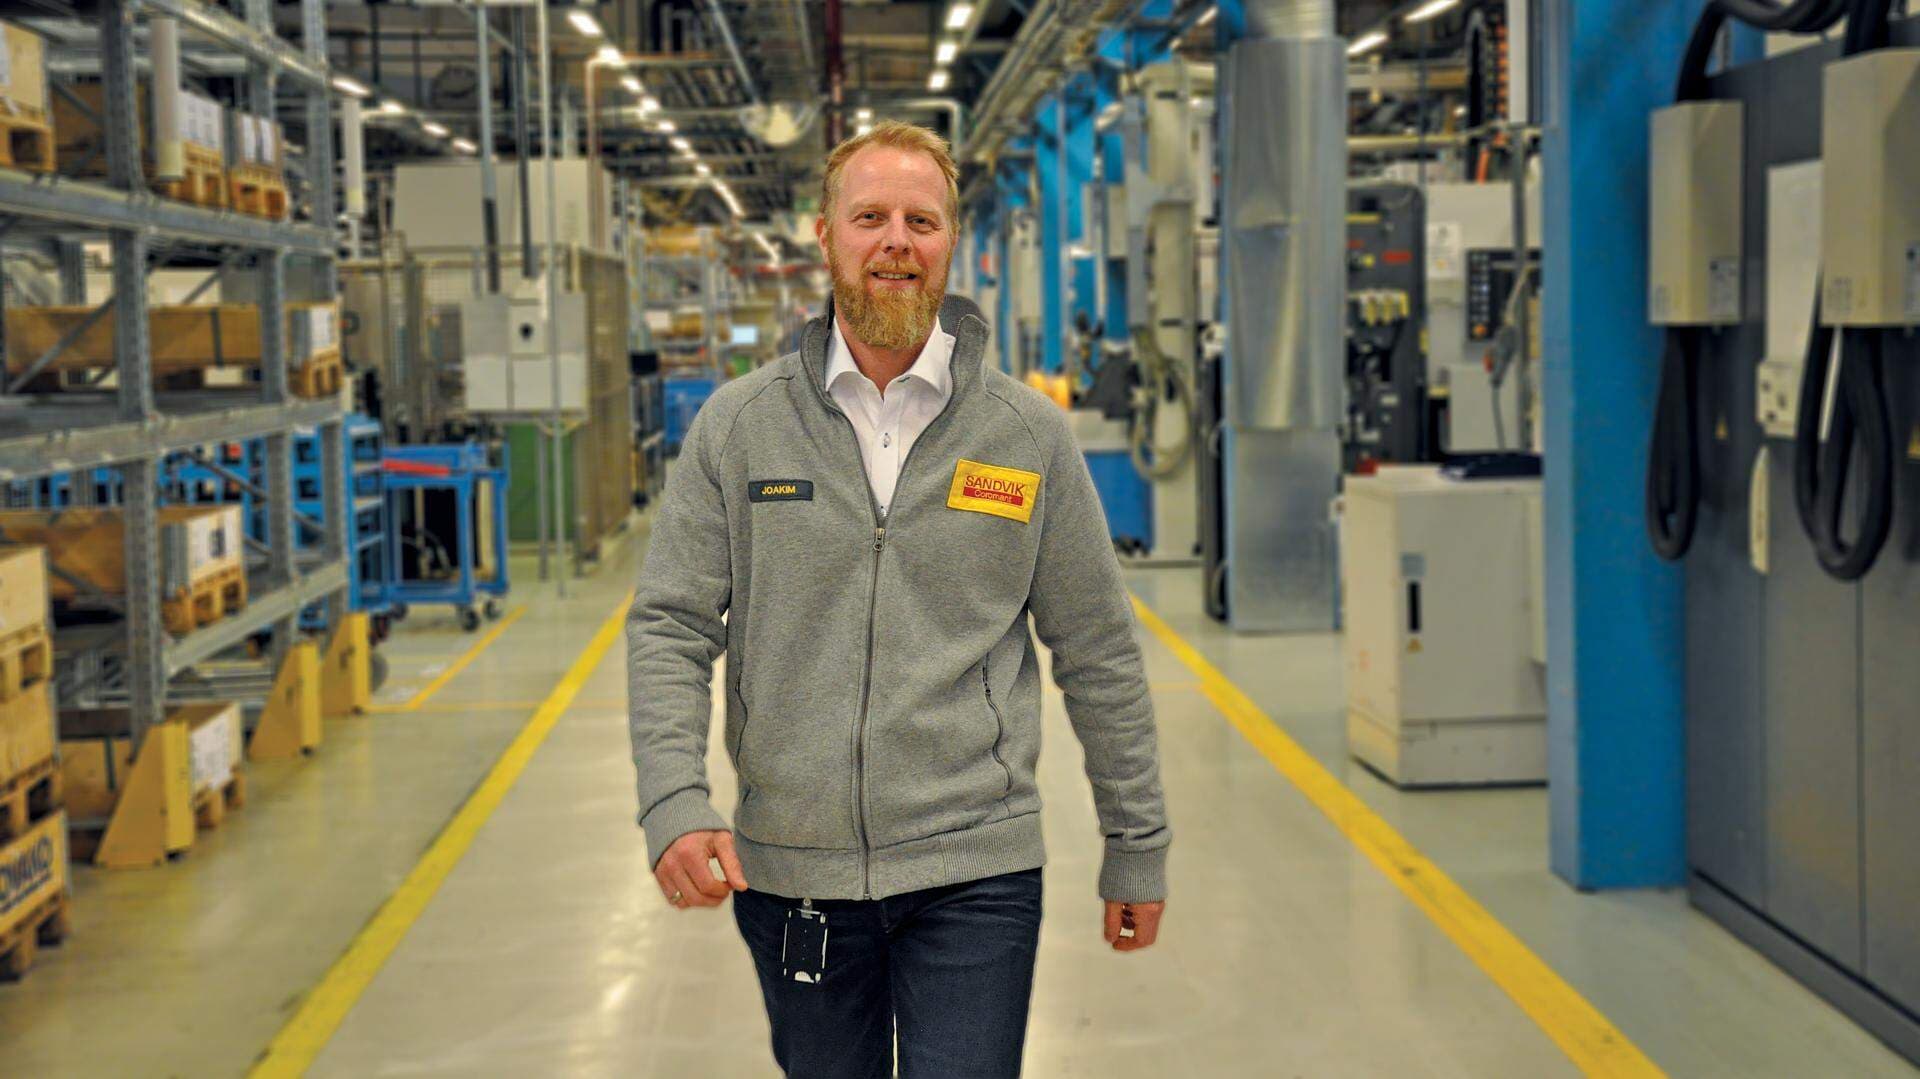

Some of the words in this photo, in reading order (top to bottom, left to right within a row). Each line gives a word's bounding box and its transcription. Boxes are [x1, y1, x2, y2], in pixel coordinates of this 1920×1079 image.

[761, 485, 797, 495] JOAKIM
[965, 475, 1026, 497] SANDVIK
[974, 489, 1013, 504] Coromant
